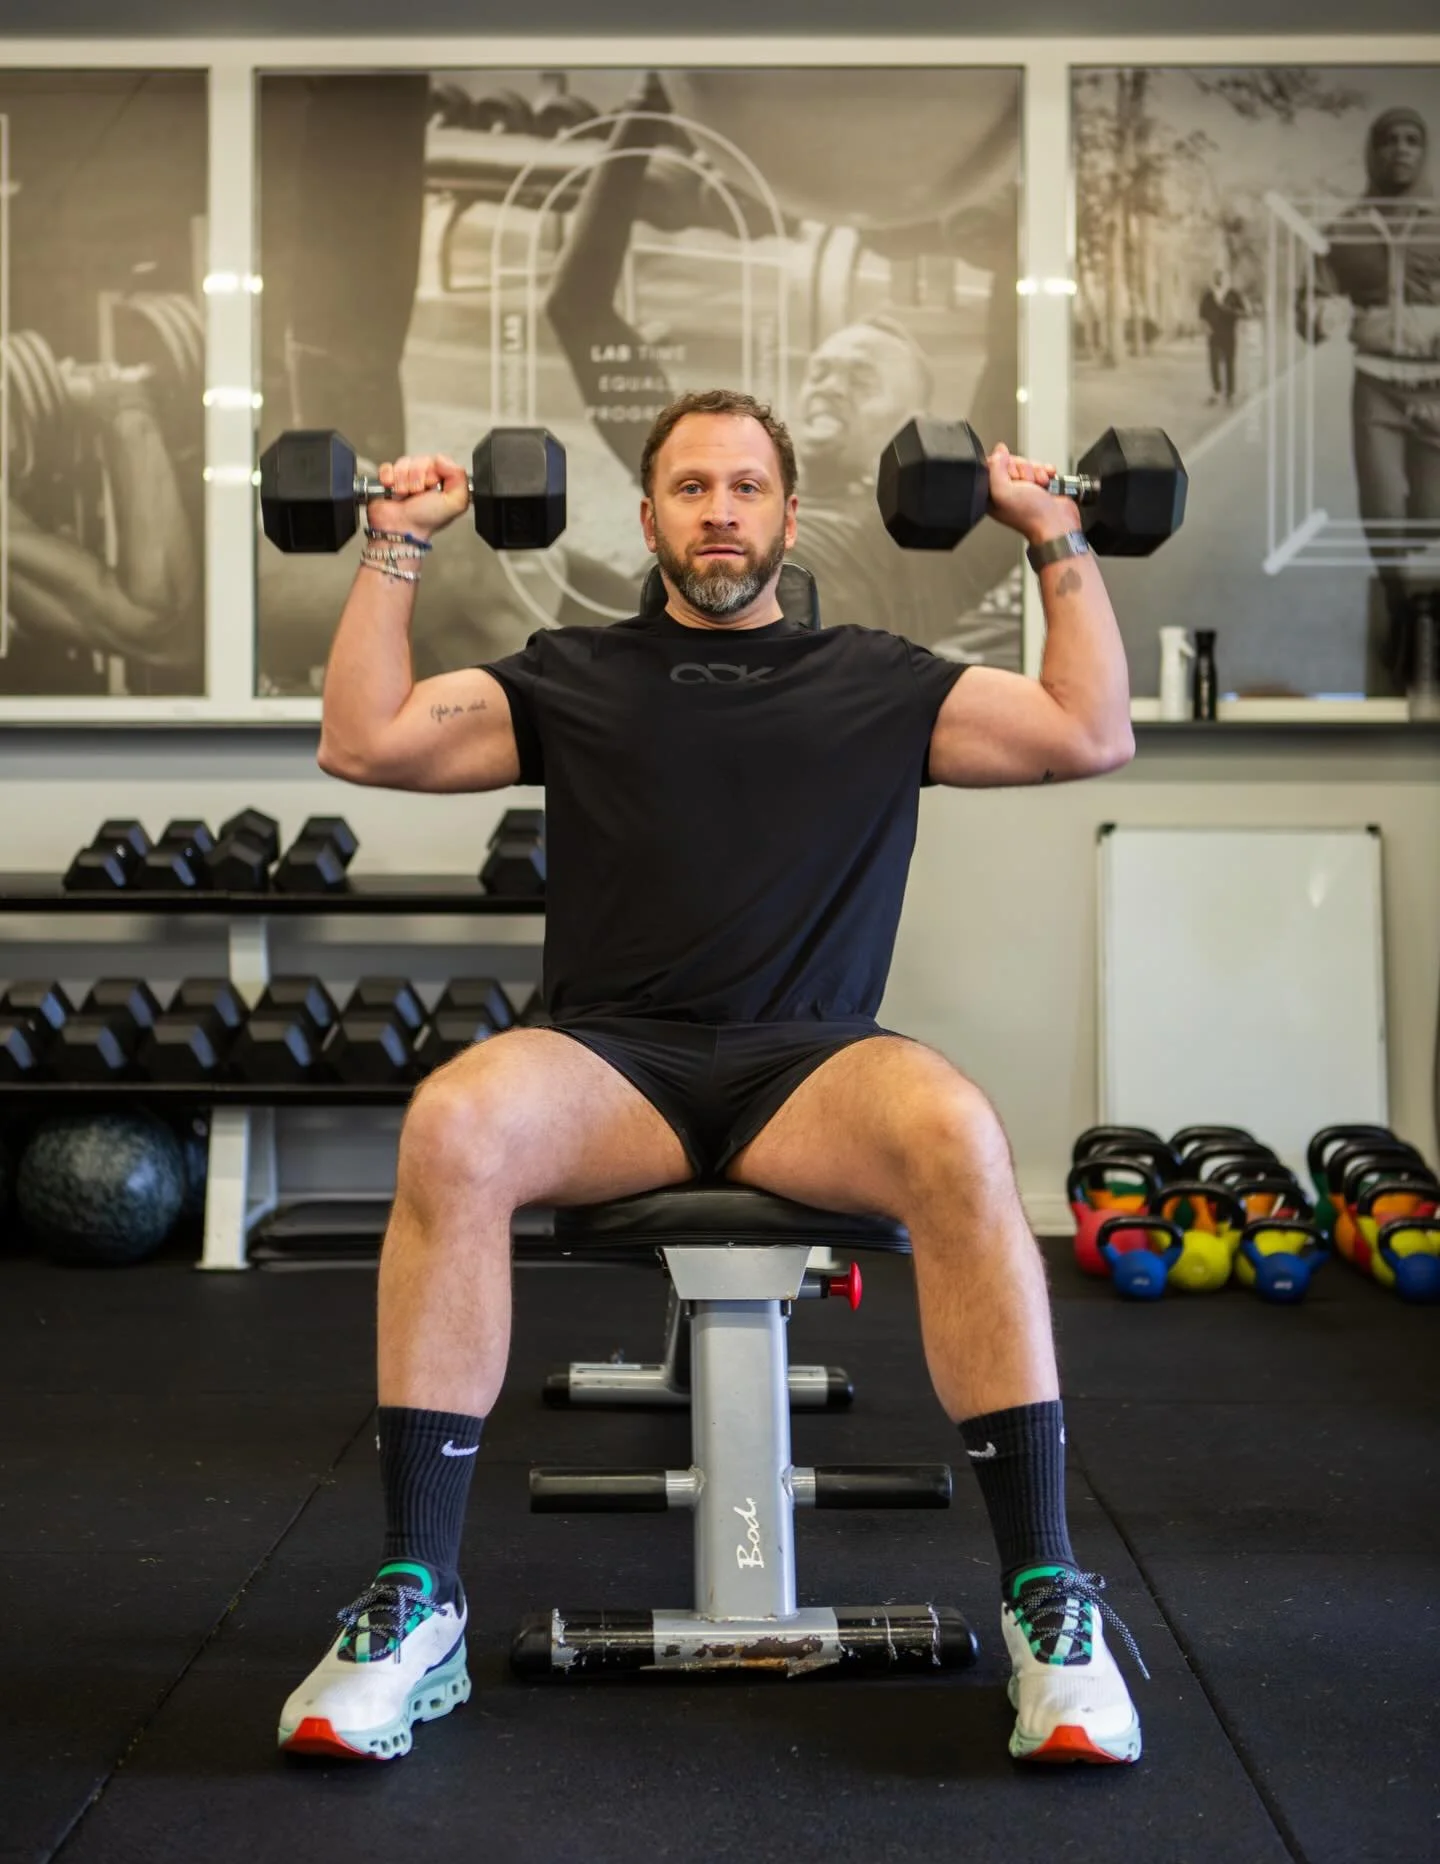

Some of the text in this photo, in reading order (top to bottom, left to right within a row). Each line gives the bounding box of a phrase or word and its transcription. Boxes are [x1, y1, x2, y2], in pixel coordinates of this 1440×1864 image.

[590, 344, 686, 362] LAB TIME
[599, 375, 677, 392] EQUAL
